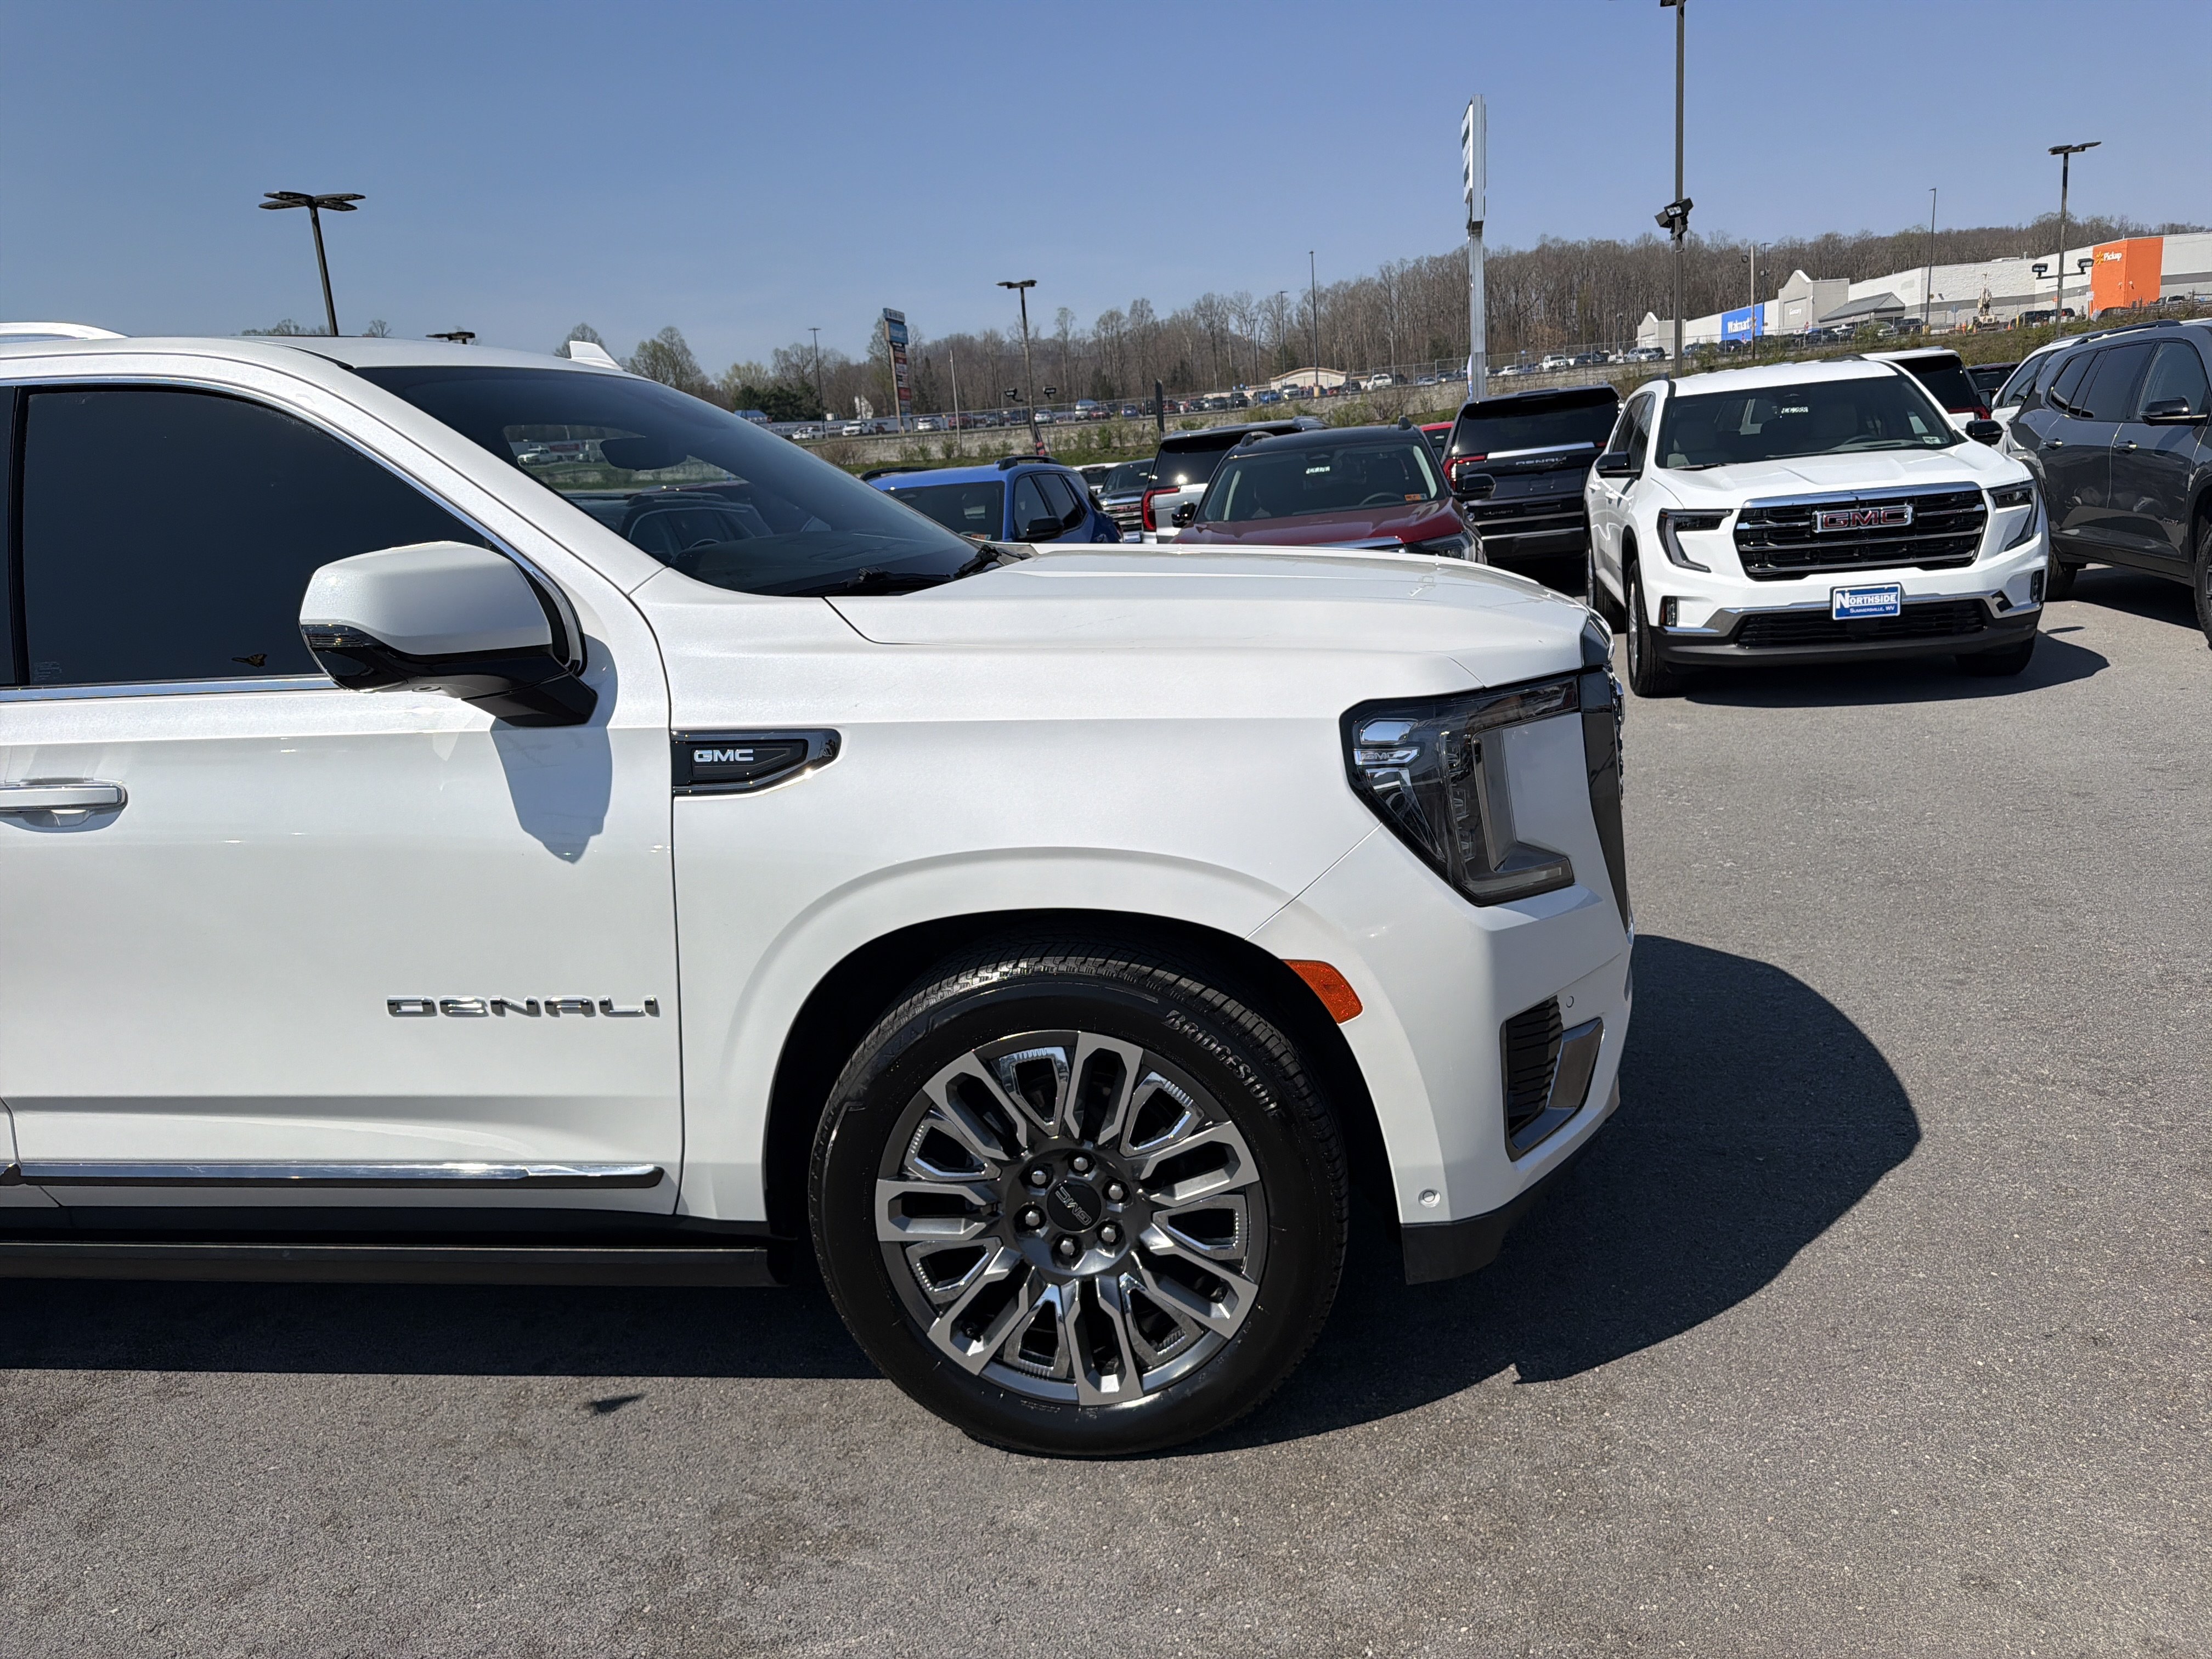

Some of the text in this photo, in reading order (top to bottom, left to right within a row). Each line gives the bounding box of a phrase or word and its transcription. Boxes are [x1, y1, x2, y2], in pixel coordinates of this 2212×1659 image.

[2103, 251, 2122, 262] Pickup
[1728, 317, 1751, 334] Walmart
[1823, 509, 1906, 529] GMC
[1836, 592, 1897, 609] NORTHSIDE
[693, 748, 754, 763] GMC
[386, 995, 659, 1017] DENALI
[1054, 1186, 1092, 1226] GMC
